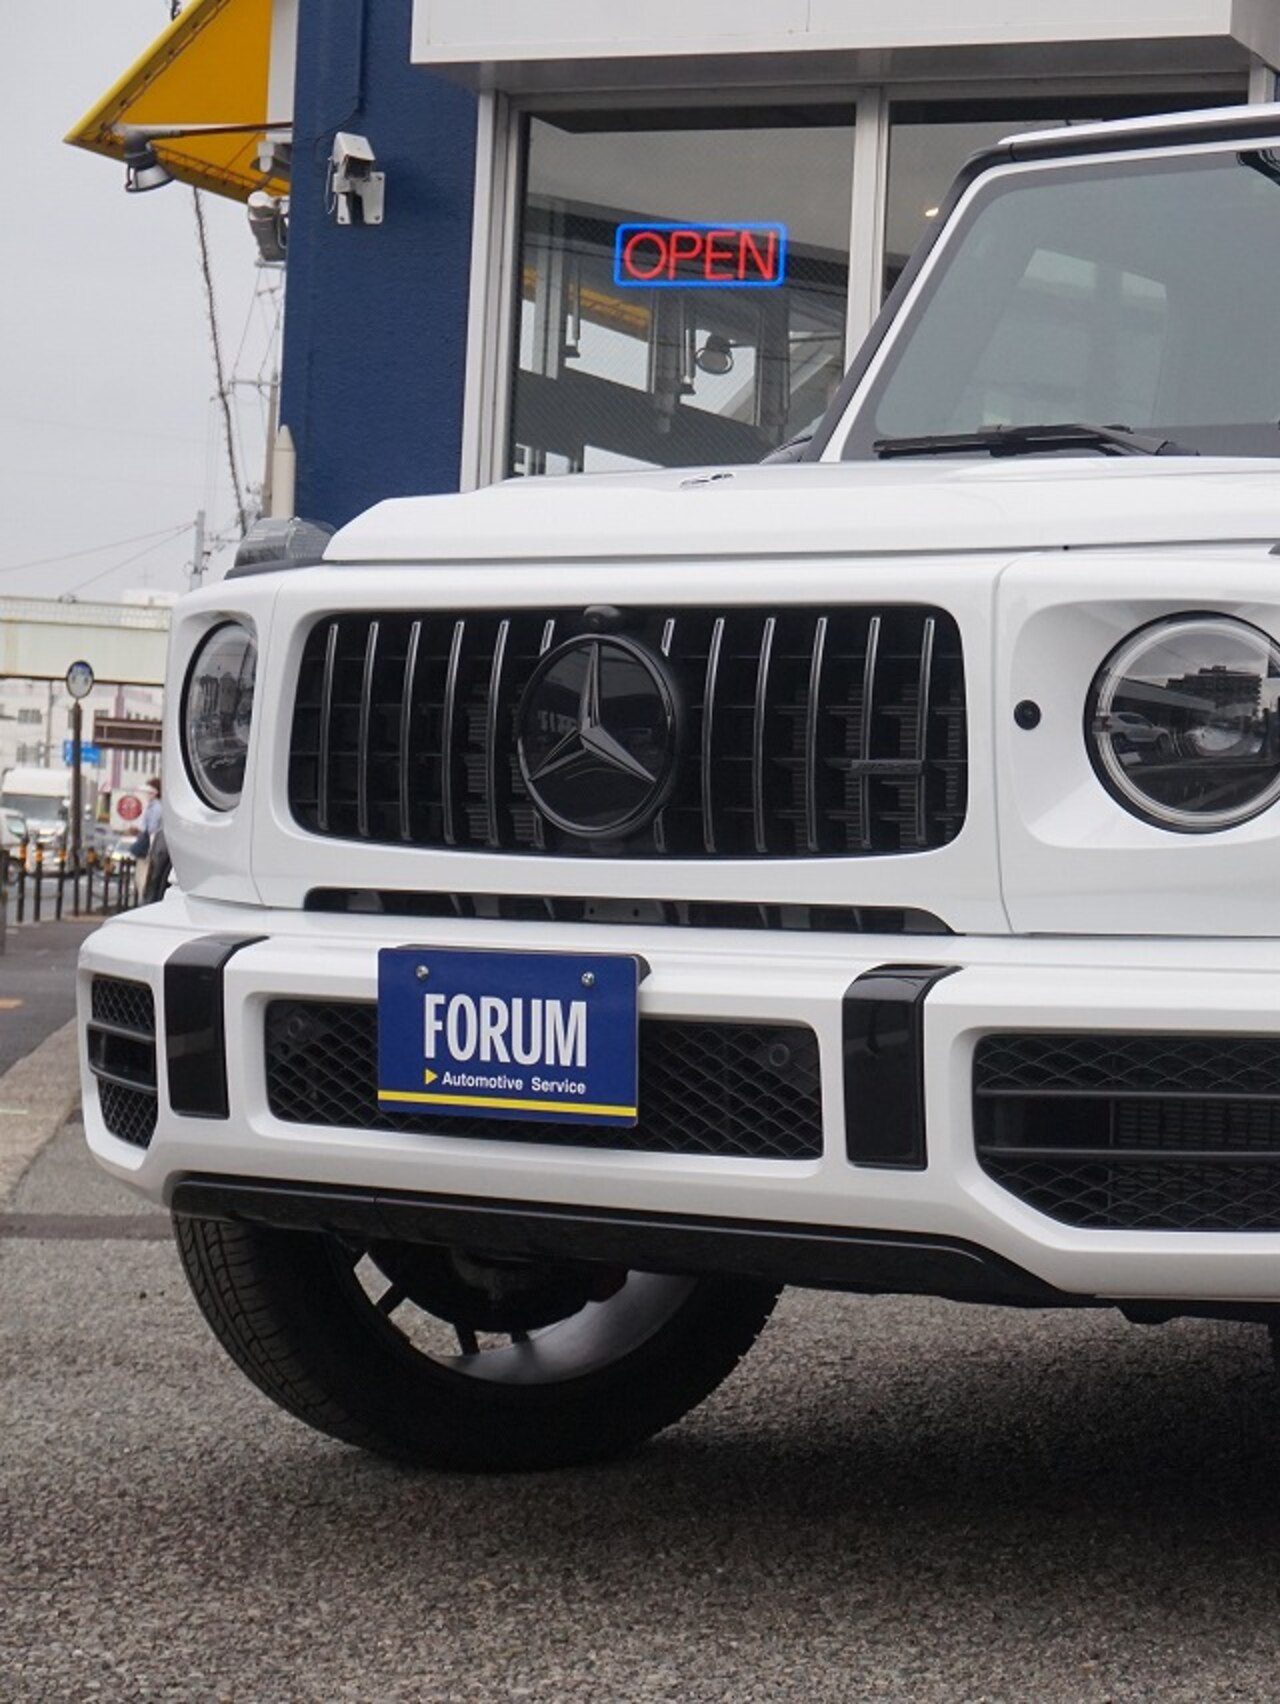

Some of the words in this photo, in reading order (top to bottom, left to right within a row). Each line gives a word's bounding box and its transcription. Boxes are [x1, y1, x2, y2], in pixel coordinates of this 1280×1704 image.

[623, 230, 777, 281] OPEN
[424, 993, 588, 1067] FORUM
[442, 1071, 524, 1092] Automotive
[530, 1076, 588, 1095] Service
